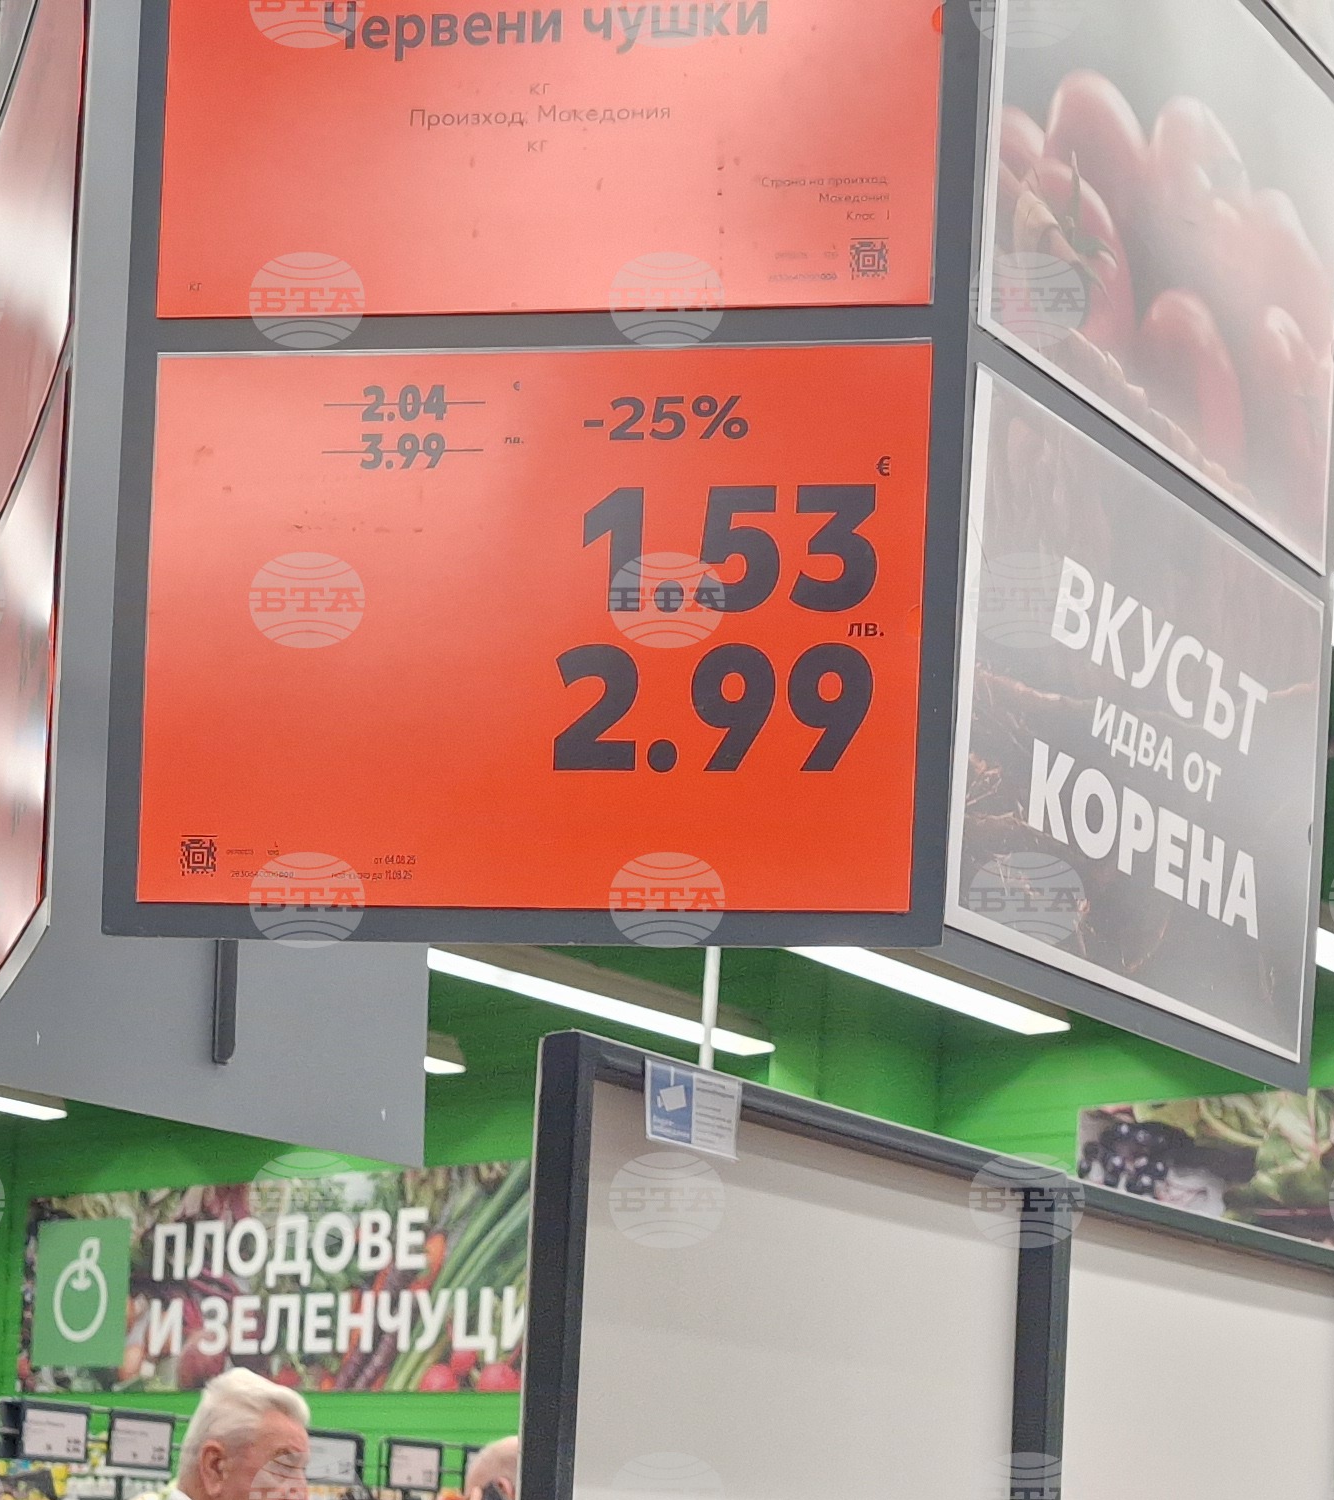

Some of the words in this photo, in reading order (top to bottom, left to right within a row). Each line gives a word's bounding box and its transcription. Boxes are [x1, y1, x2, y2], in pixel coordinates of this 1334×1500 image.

[322, 0, 563, 61] Червени
[583, 0, 769, 54] чушки
[529, 83, 551, 95] кг
[537, 104, 672, 125] Македония
[527, 140, 548, 152] кг
[361, 384, 448, 421] 2.04
[583, 395, 750, 441] -25%
[359, 432, 447, 470] 3.99
[582, 483, 880, 613] 1.53
[875, 456, 892, 477] €
[847, 621, 885, 637] лв.
[1050, 555, 1268, 756] ВКУСЪТ
[553, 642, 875, 773] 2.99
[1090, 696, 1174, 781] ИДВА
[1182, 751, 1222, 802] ОТ
[1027, 737, 1259, 940] КОРЕНА
[151, 1207, 430, 1289] ПЛОДОВЕ
[148, 1298, 184, 1357] И
[197, 1286, 525, 1363] ЗЕЛЕНЧУЦИ
